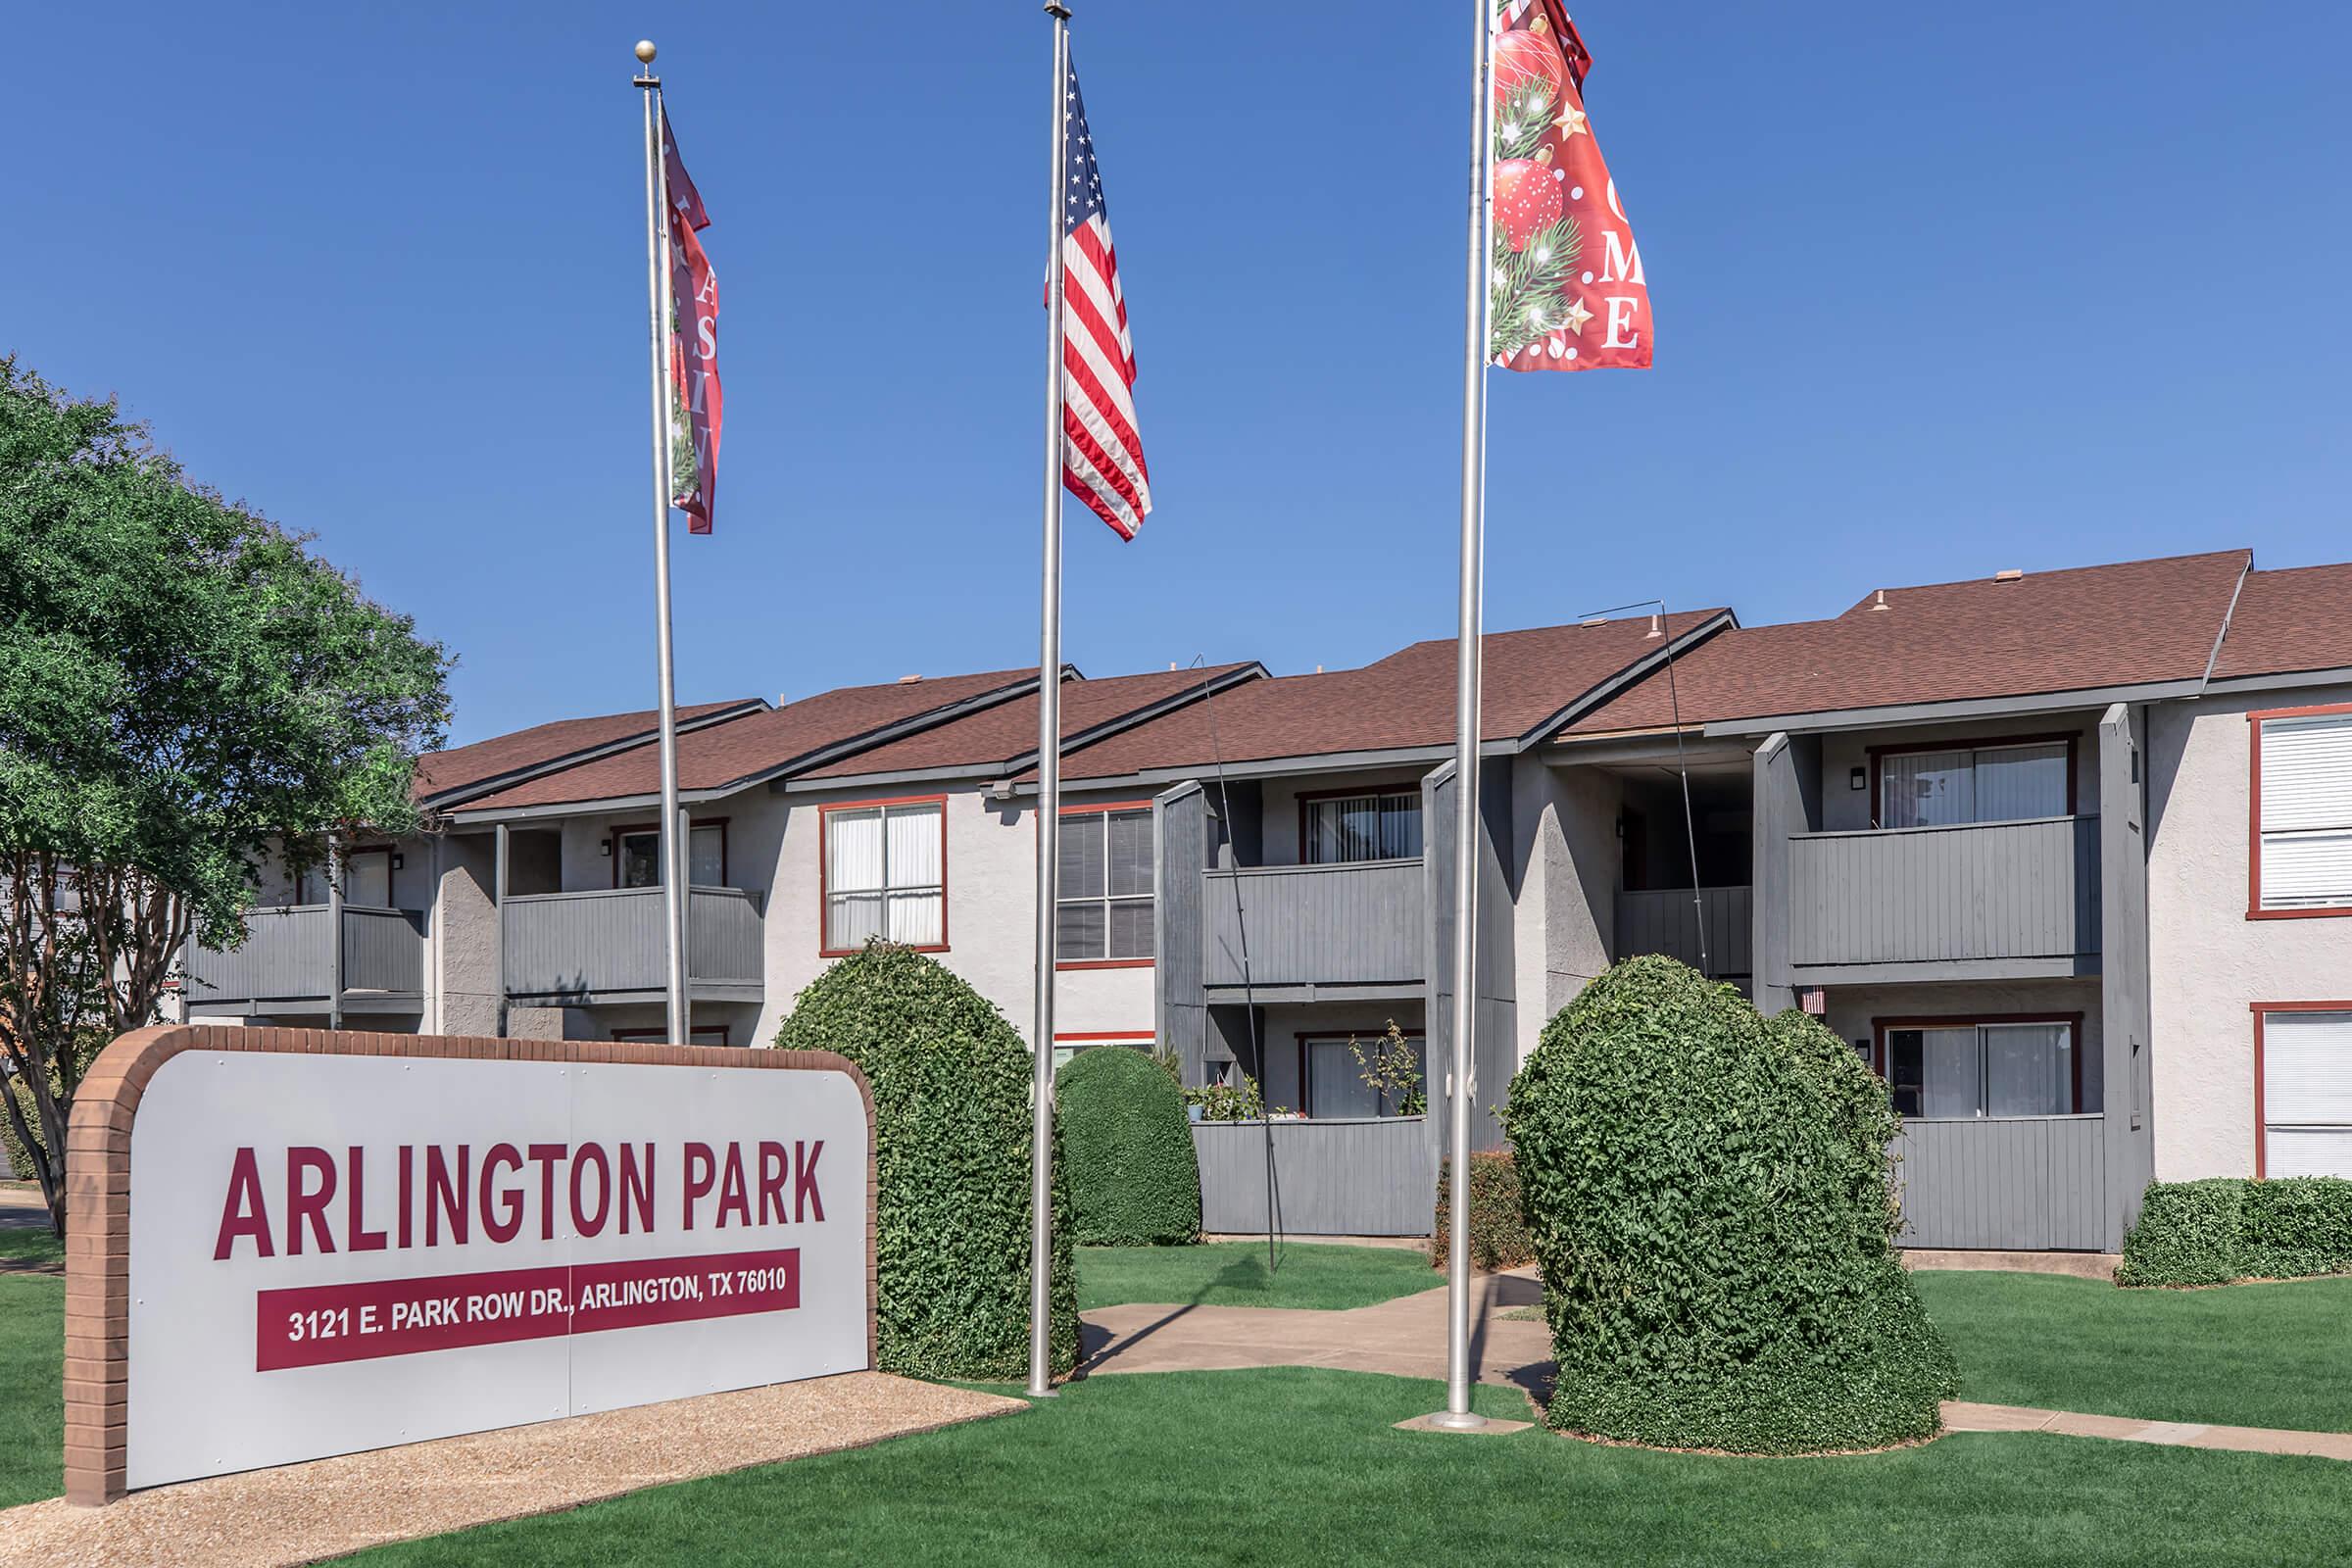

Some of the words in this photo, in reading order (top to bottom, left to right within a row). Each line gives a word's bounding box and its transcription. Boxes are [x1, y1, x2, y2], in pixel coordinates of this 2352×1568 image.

[214, 1143, 655, 1260] ARLINGTON
[683, 1140, 825, 1231] PARK
[288, 1307, 349, 1342] 3121
[359, 1305, 384, 1335] E.
[392, 1297, 461, 1331] PARK
[466, 1291, 525, 1322] ROW
[530, 1288, 575, 1316] DR.,
[579, 1275, 704, 1311] ARLINGTON,
[708, 1272, 734, 1298] TX
[737, 1266, 787, 1295] 76010
